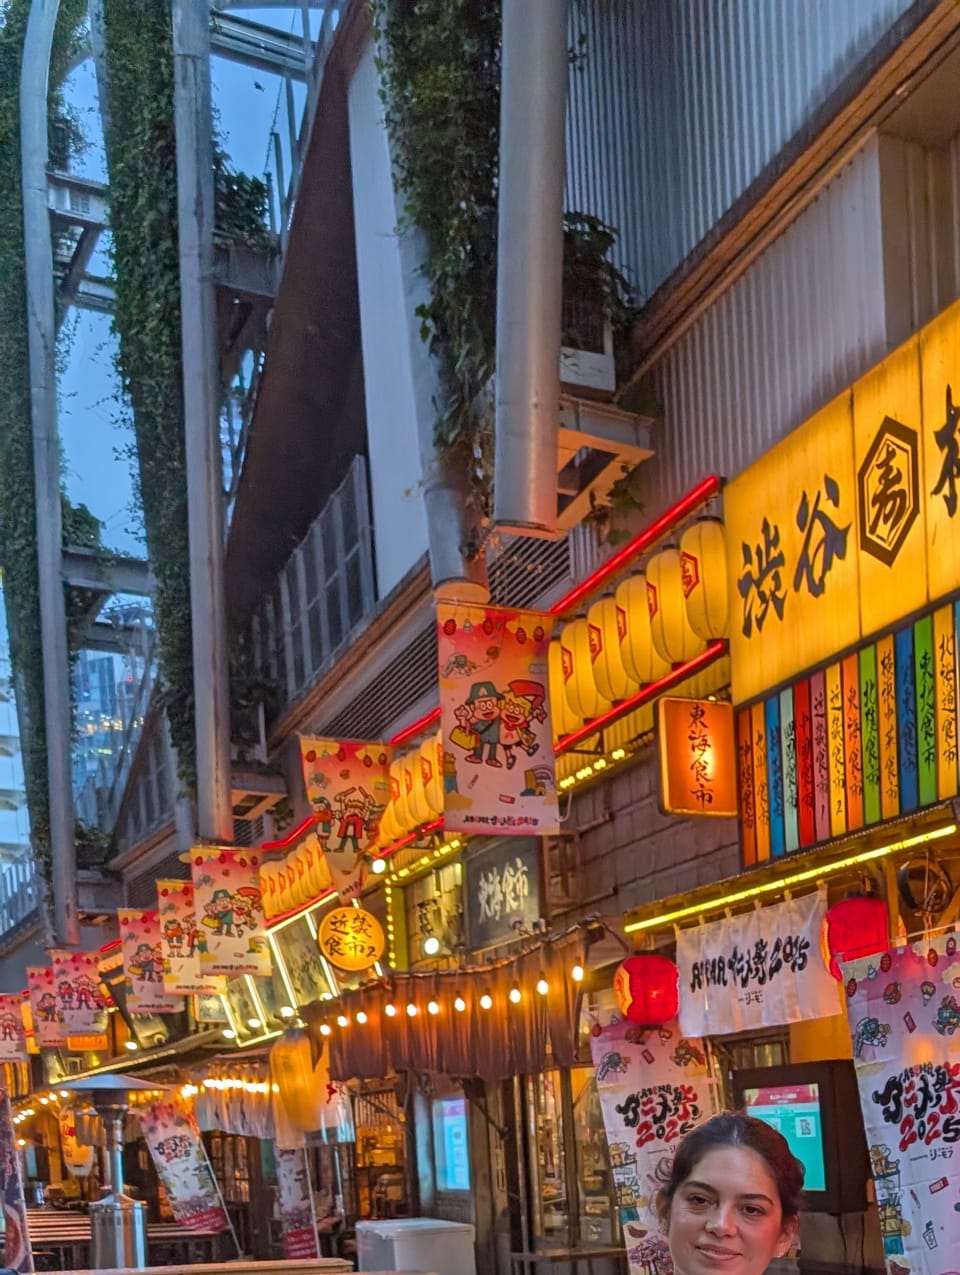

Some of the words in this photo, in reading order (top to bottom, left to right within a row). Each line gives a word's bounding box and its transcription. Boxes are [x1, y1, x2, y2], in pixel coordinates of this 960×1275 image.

[738, 473, 852, 638] 渋谷
[687, 703, 715, 808] 東海食市
[848, 687, 863, 801] 東海食市
[919, 650, 936, 772] 東北食市
[939, 632, 958, 769] 北海道食市
